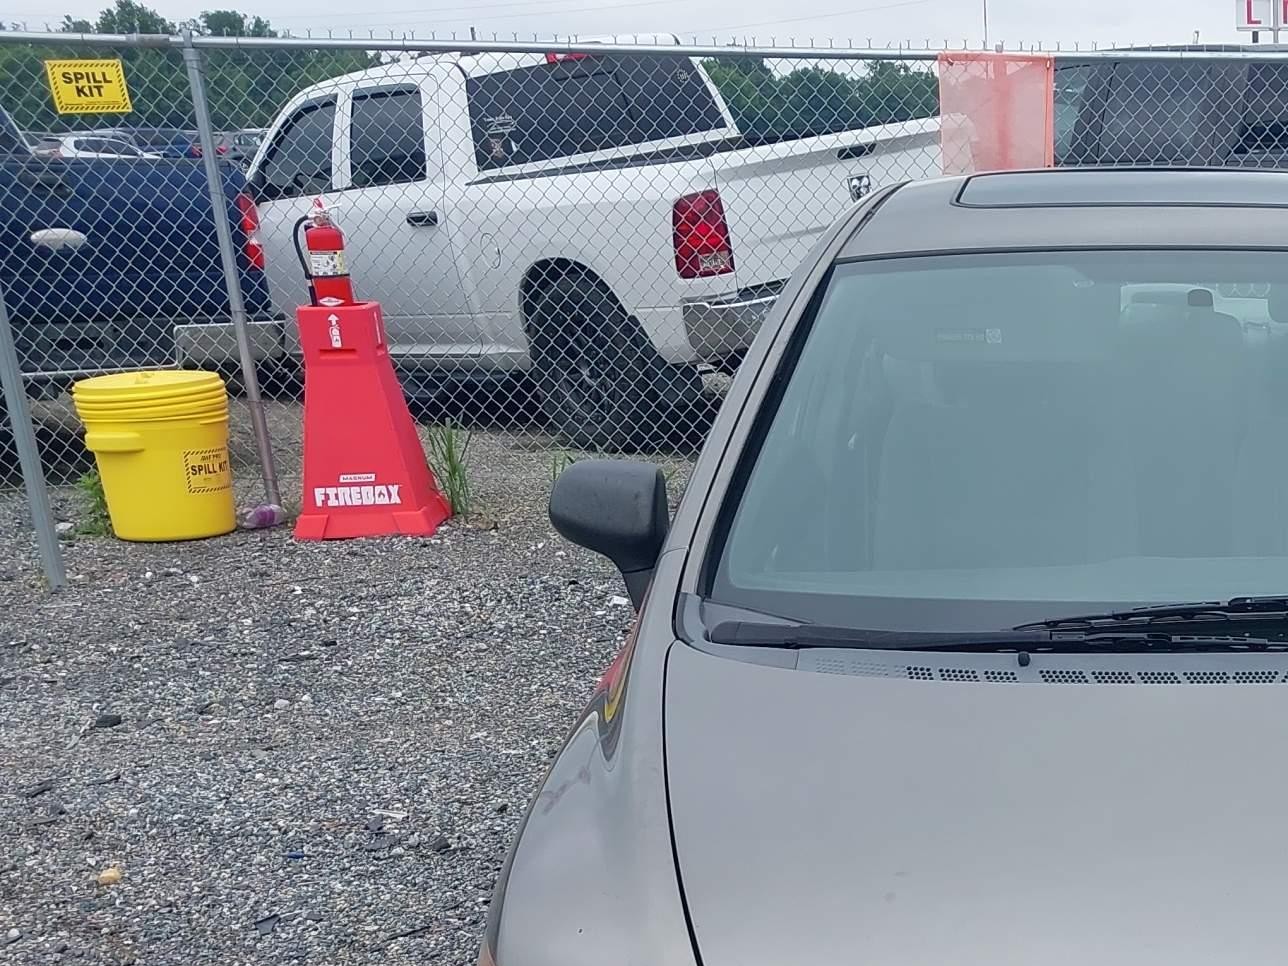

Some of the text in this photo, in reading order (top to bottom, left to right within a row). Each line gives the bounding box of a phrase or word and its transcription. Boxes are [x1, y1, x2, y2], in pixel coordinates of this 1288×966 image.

[61, 71, 113, 85] SPILL
[75, 85, 104, 98] KIT
[190, 463, 218, 476] SPILL
[314, 484, 402, 507] FIREBOX
